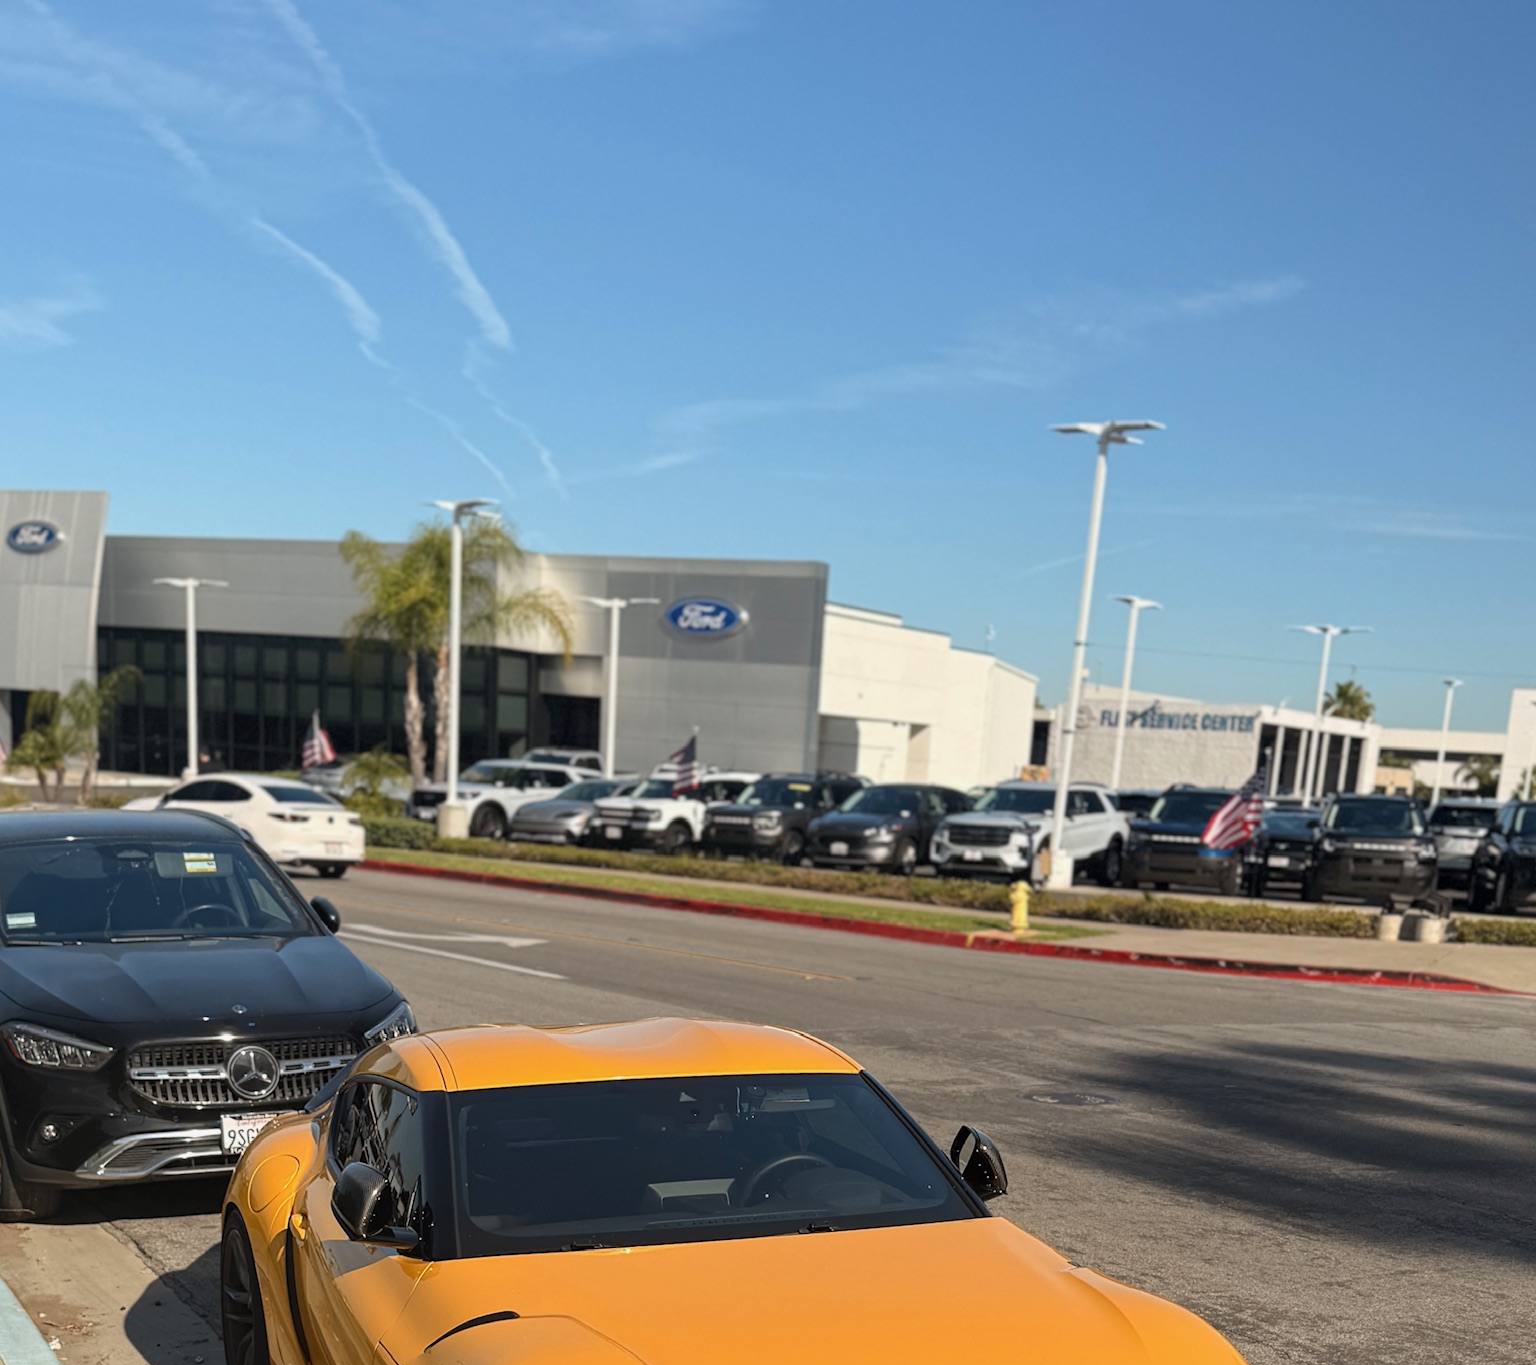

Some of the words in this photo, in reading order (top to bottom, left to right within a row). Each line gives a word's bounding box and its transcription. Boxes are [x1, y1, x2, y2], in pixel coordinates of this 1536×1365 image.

[16, 525, 49, 545] Ford
[677, 603, 727, 630] Ford
[1140, 711, 1198, 730] SERVICE
[1201, 713, 1255, 732] CENTER
